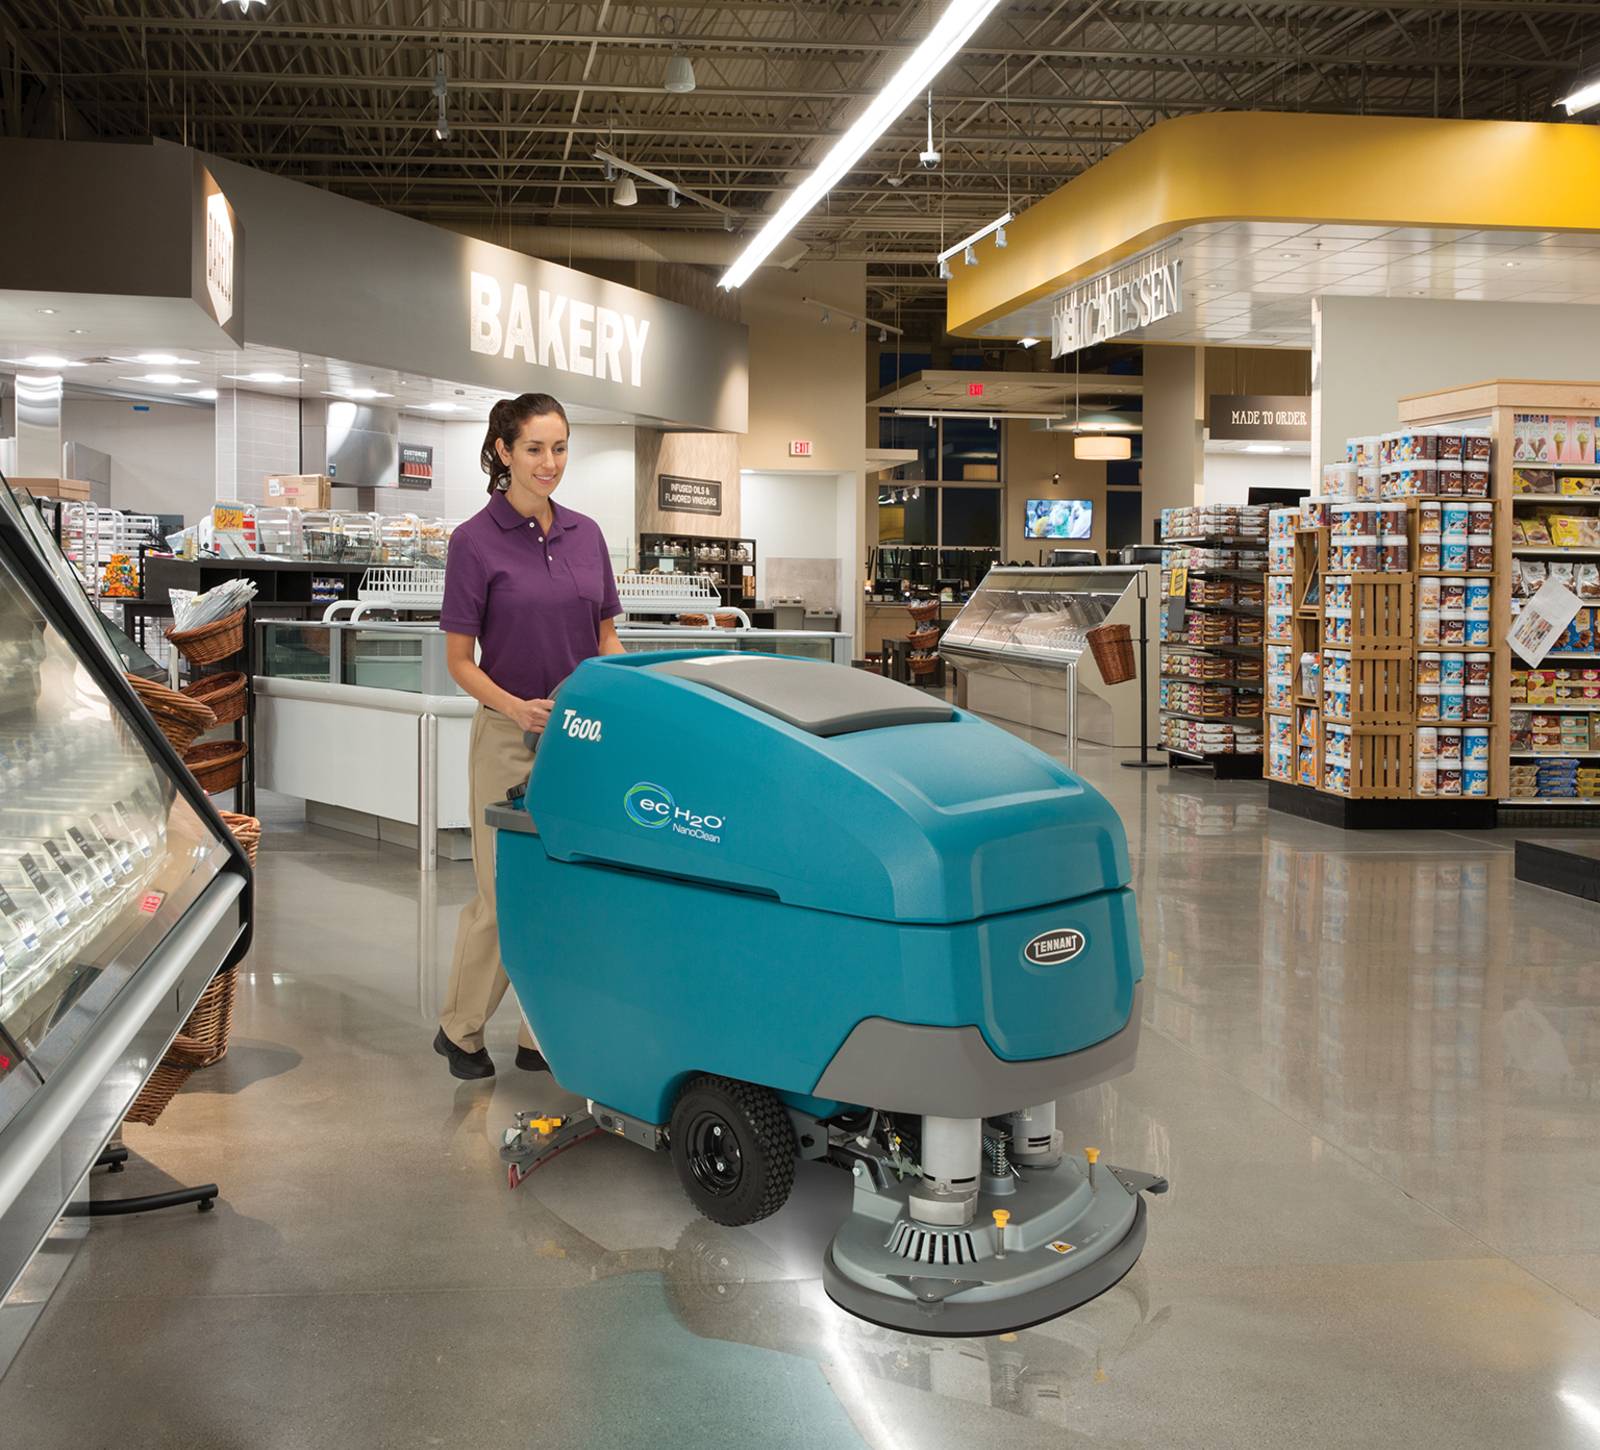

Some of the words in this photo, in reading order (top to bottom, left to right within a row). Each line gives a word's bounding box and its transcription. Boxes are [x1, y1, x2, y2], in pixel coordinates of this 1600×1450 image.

[470, 271, 650, 387] BAKERY
[1231, 410, 1260, 425] MADE
[1262, 411, 1273, 425] TO
[1276, 411, 1307, 425] ORDER
[794, 441, 809, 454] EXIT
[670, 483, 692, 494] INFUSED
[693, 485, 705, 495] OILS
[664, 492, 691, 504] FLAVORED
[692, 496, 717, 506] VINEGARS
[672, 823, 721, 844] NanoClean
[1033, 934, 1078, 958] TENNANT
